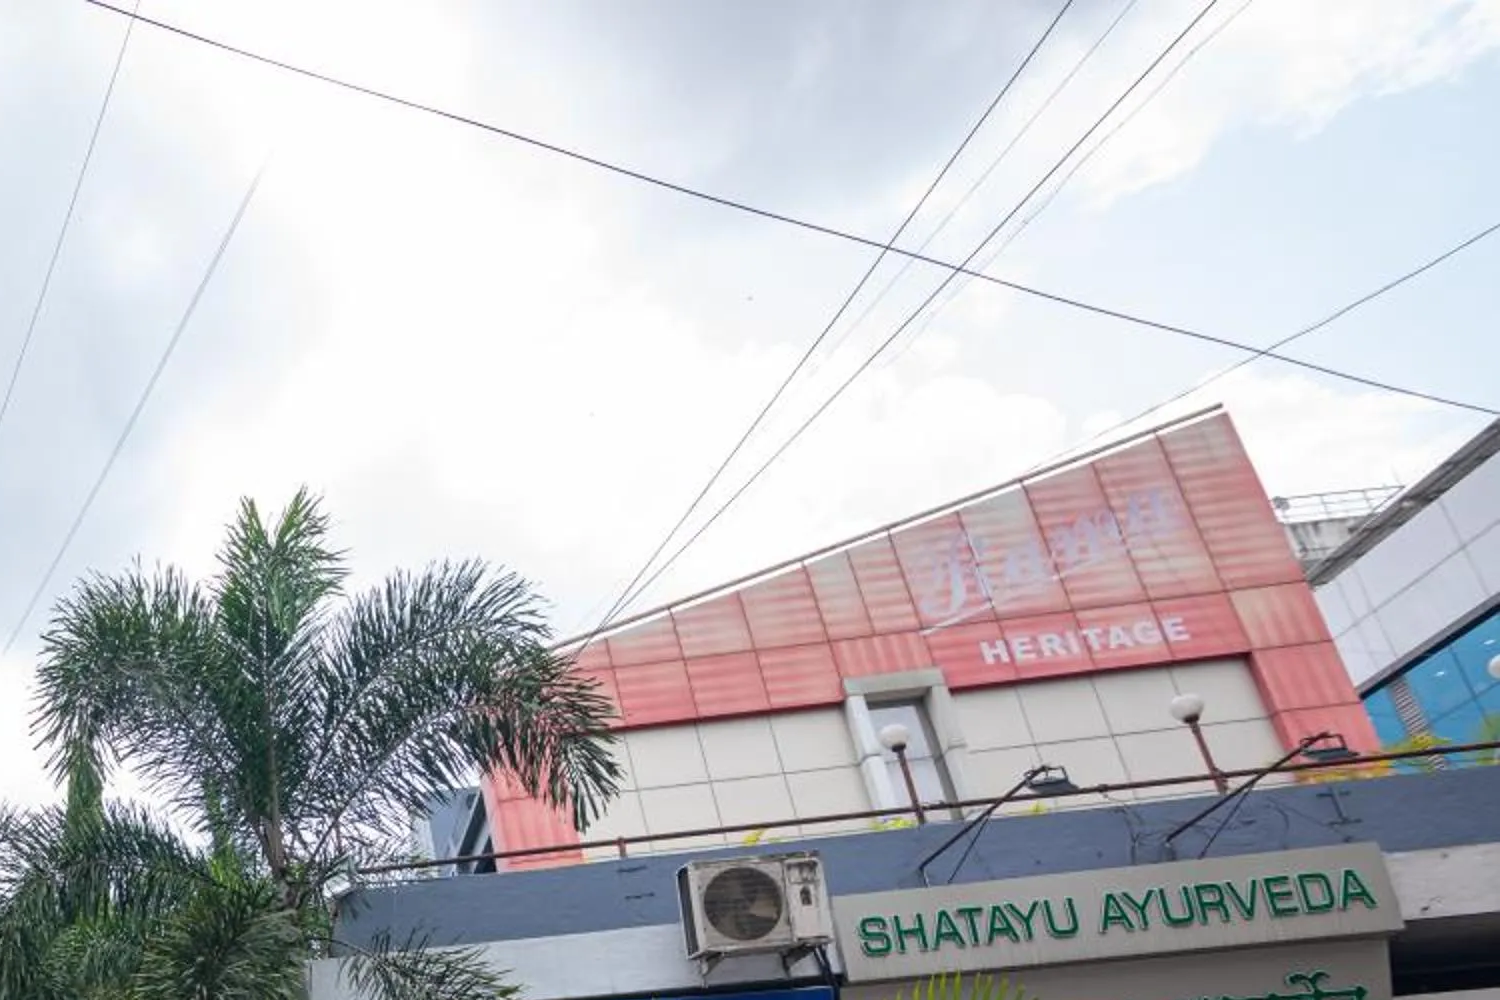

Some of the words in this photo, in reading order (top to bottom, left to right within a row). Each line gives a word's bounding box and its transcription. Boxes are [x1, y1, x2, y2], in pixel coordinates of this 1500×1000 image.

[979, 616, 1191, 665] HERITAGE
[857, 896, 1081, 958] SHATAYU
[1100, 867, 1378, 934] AYURVEDA
